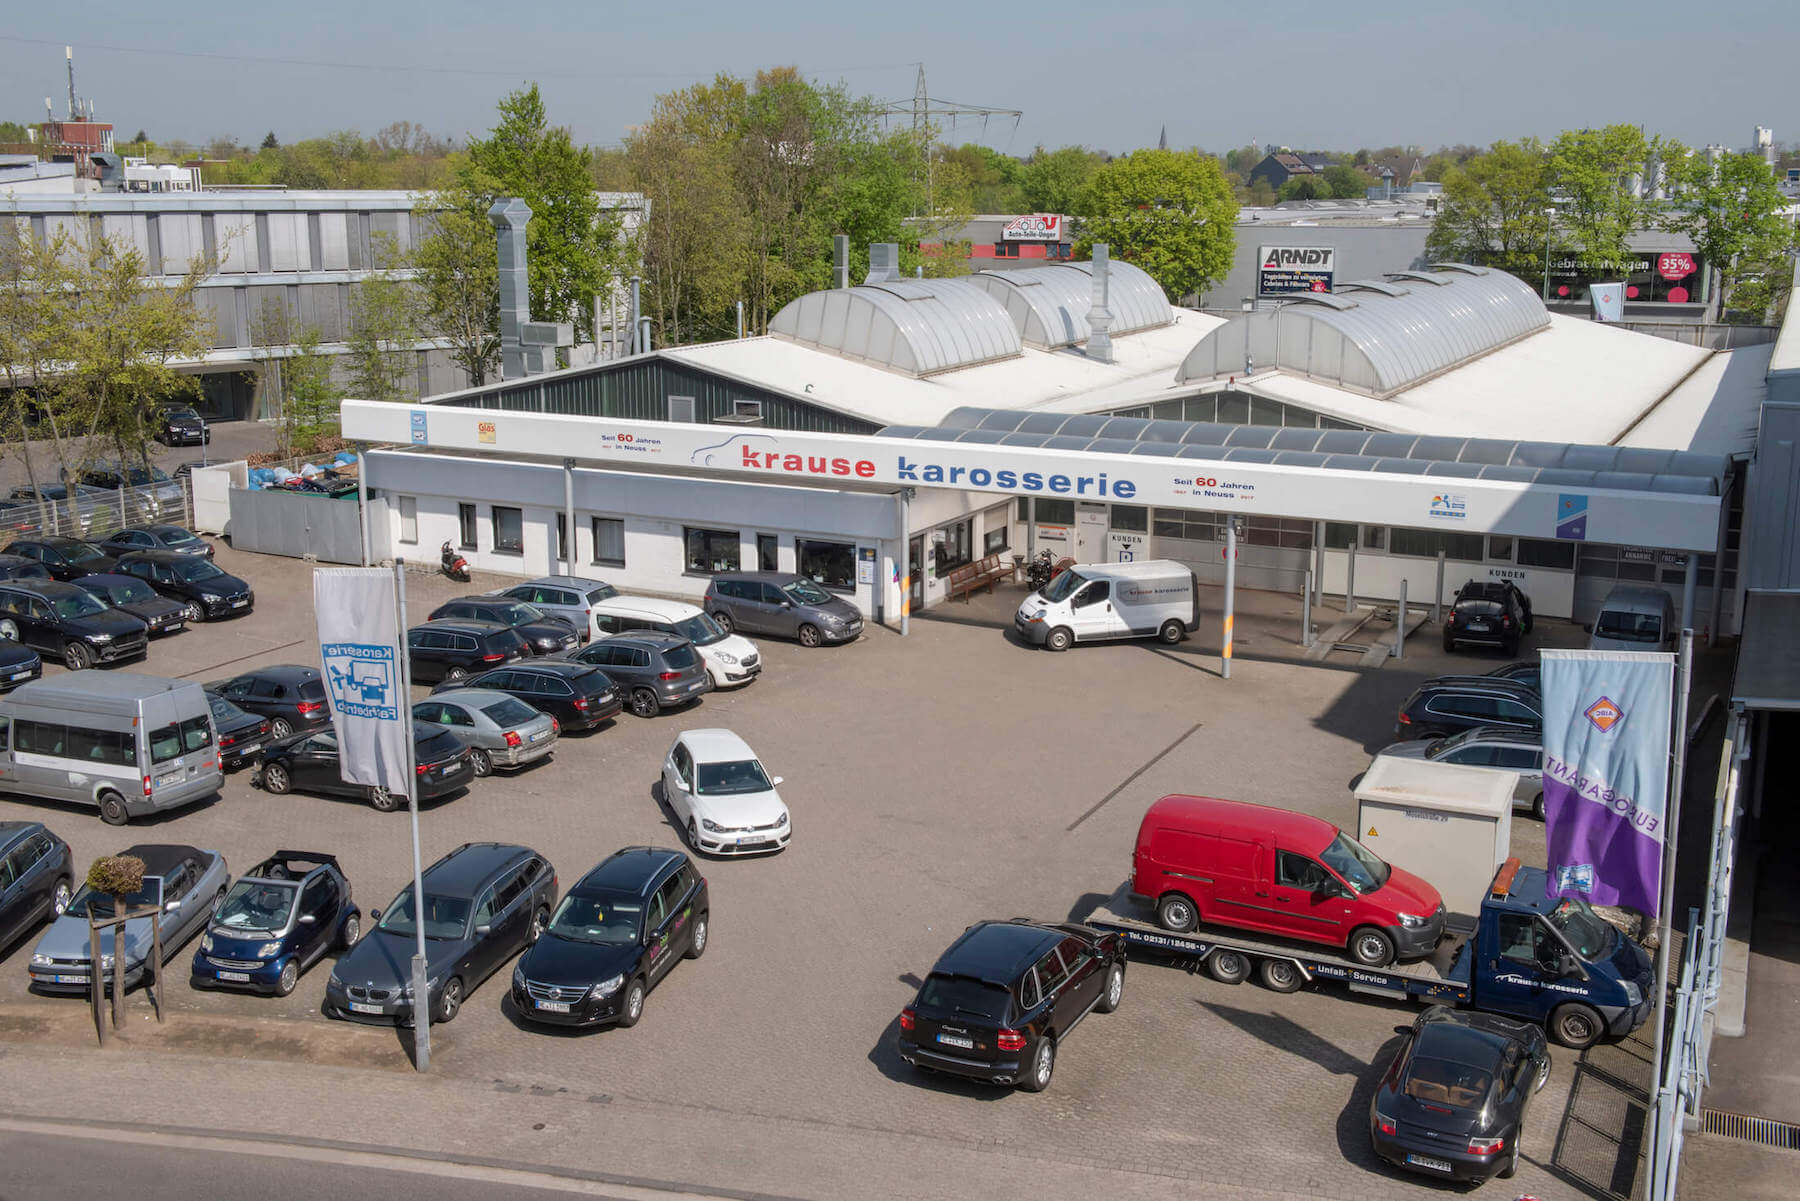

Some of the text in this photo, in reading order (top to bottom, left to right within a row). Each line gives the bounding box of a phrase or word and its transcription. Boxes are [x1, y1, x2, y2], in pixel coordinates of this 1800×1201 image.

[1266, 249, 1332, 267] ARNDT
[1662, 258, 1690, 270] 35%
[617, 433, 633, 442] 60
[742, 445, 876, 478] krause
[898, 456, 1136, 499] karosserie
[1196, 477, 1217, 487] 60
[1220, 482, 1255, 490] Jahren
[1204, 490, 1235, 498] Neuss
[1112, 535, 1142, 543] KUNDEN
[1489, 569, 1525, 579] KUNDEN
[1129, 932, 1142, 940] Tel.
[1318, 964, 1388, 985] Unfall- Service
[1508, 975, 1589, 995] krause karosserie
